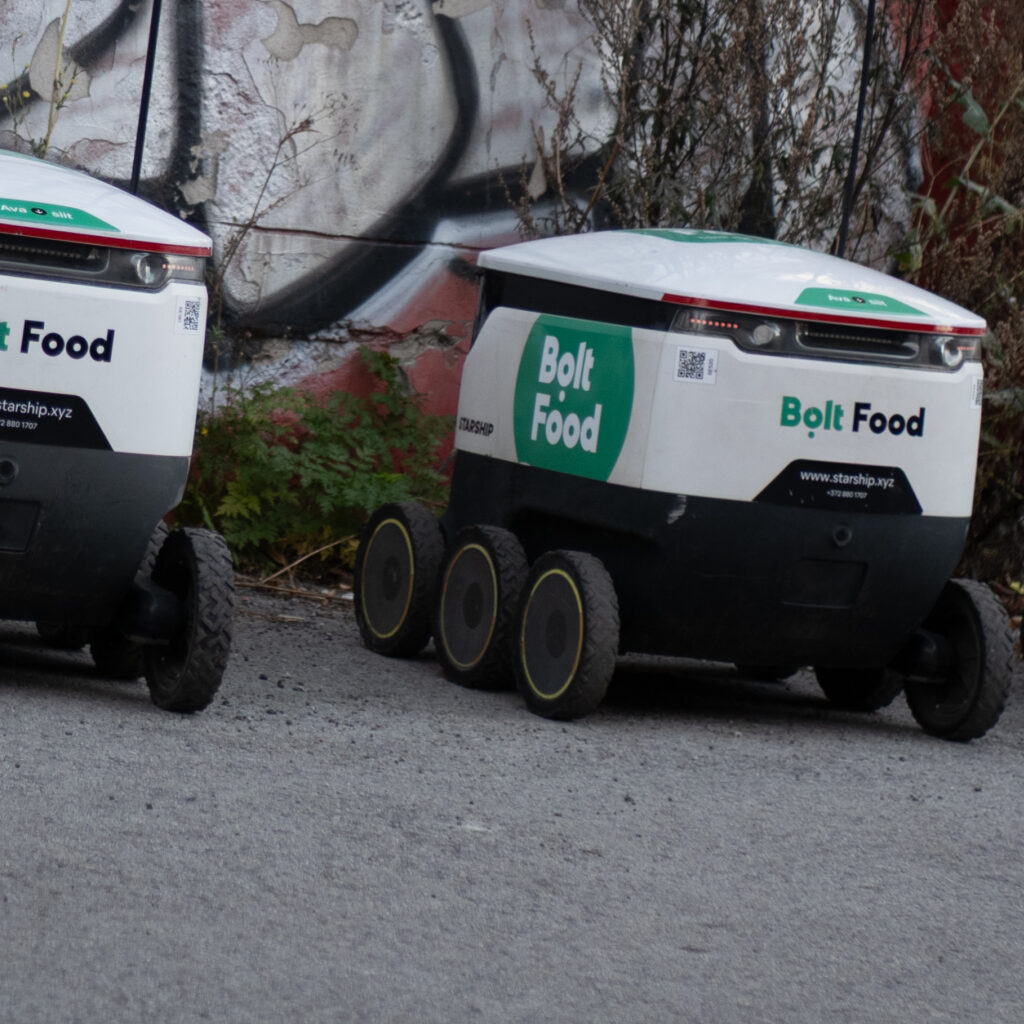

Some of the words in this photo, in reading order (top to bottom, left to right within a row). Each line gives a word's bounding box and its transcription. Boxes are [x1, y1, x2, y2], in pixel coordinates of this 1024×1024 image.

[0, 204, 28, 214] Ava
[20, 319, 115, 363] Food
[538, 334, 595, 402] Bolt
[6, 419, 21, 428] 880
[21, 421, 38, 430] 1707
[458, 417, 494, 437] STARSHIP
[531, 392, 603, 453] Food
[780, 395, 844, 439] Bolt
[852, 401, 926, 437] Food
[800, 470, 895, 489] www.starship.xyz
